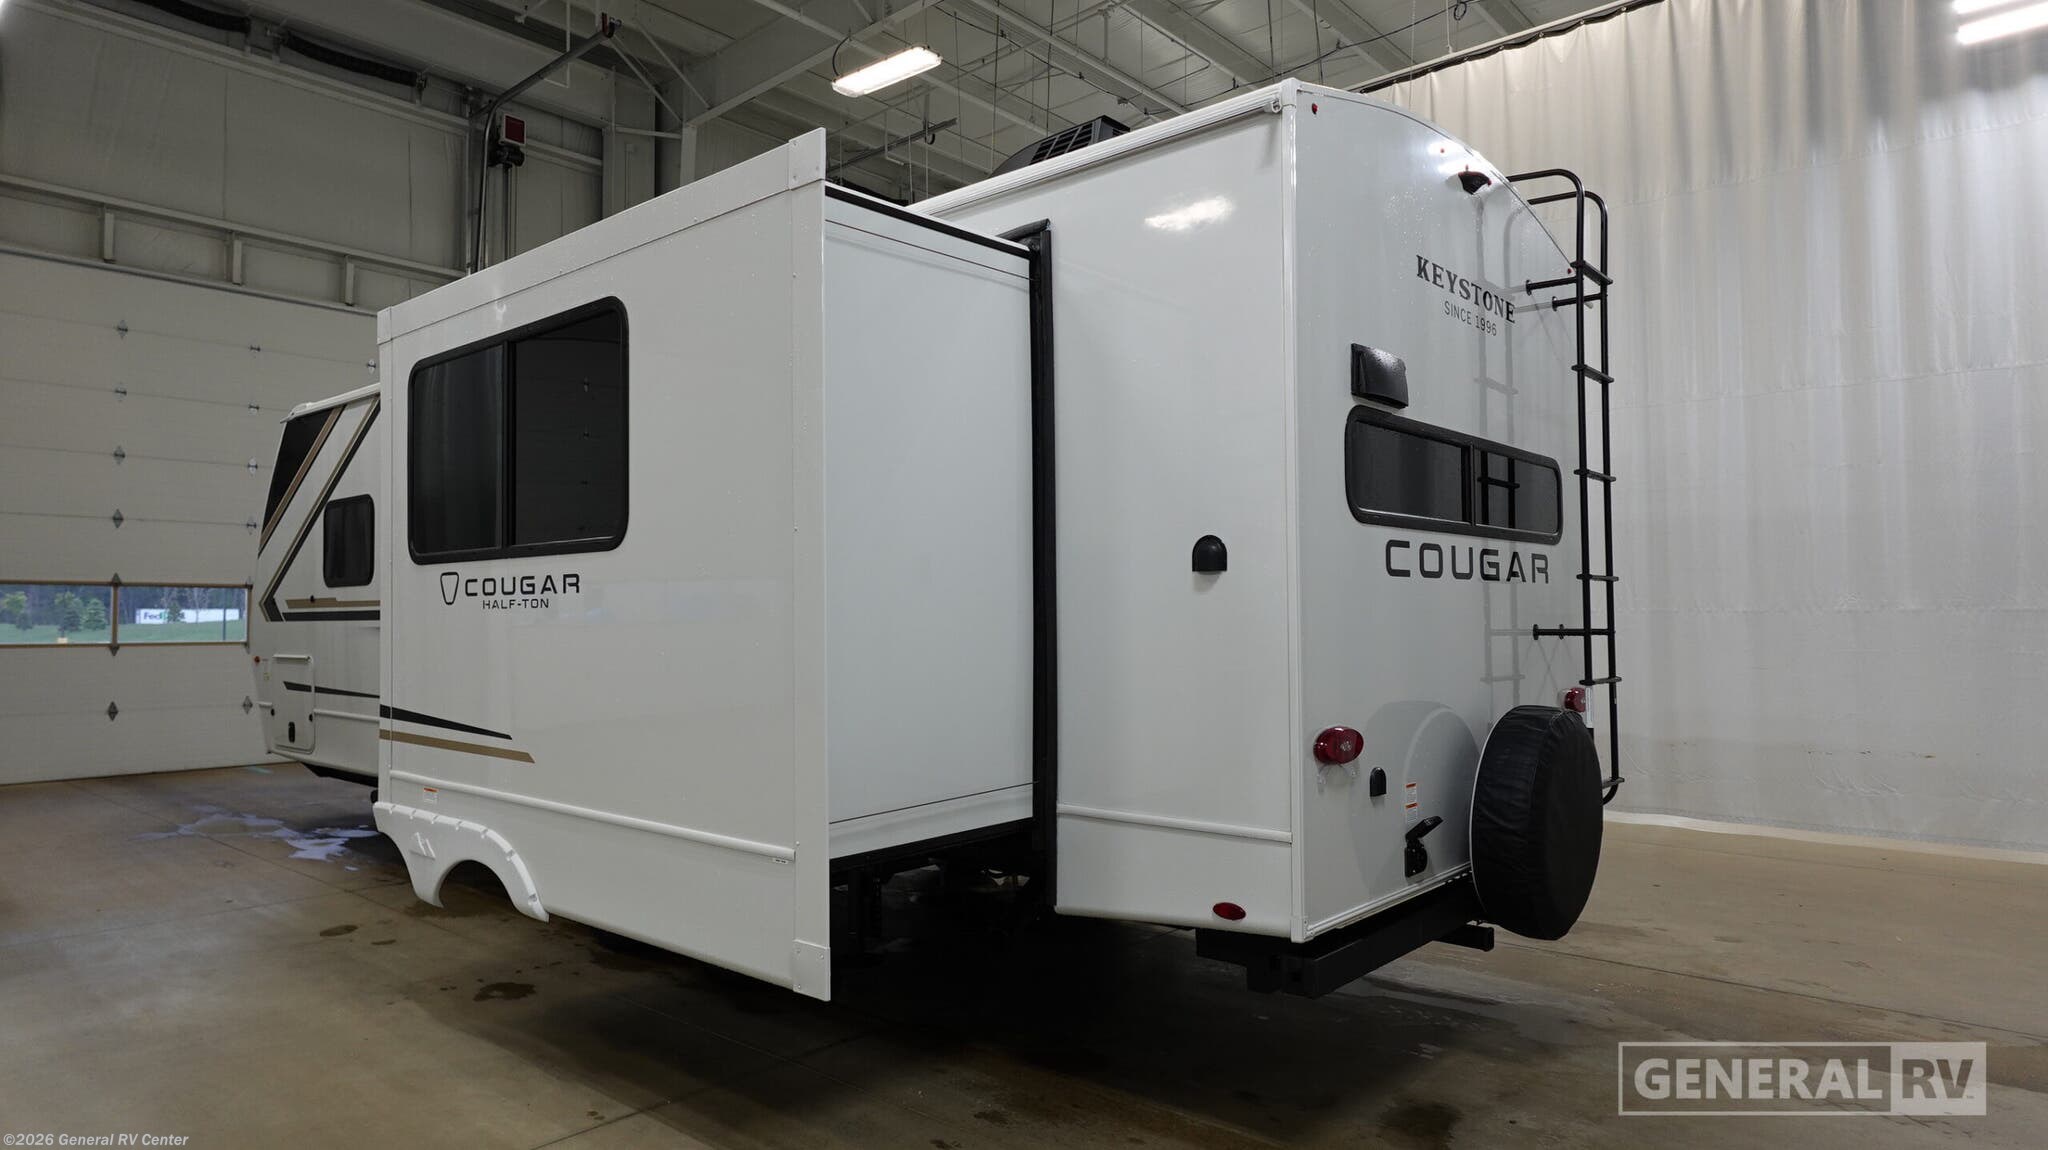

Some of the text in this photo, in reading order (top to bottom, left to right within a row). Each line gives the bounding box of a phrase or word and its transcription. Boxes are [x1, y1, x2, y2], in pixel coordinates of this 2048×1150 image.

[1416, 254, 1515, 324] KEYSTONE
[1444, 300, 1497, 336] SINCE 1996
[1385, 539, 1549, 584] COUGAR
[465, 573, 580, 597] COUGAR
[482, 598, 549, 609] HALF-TON
